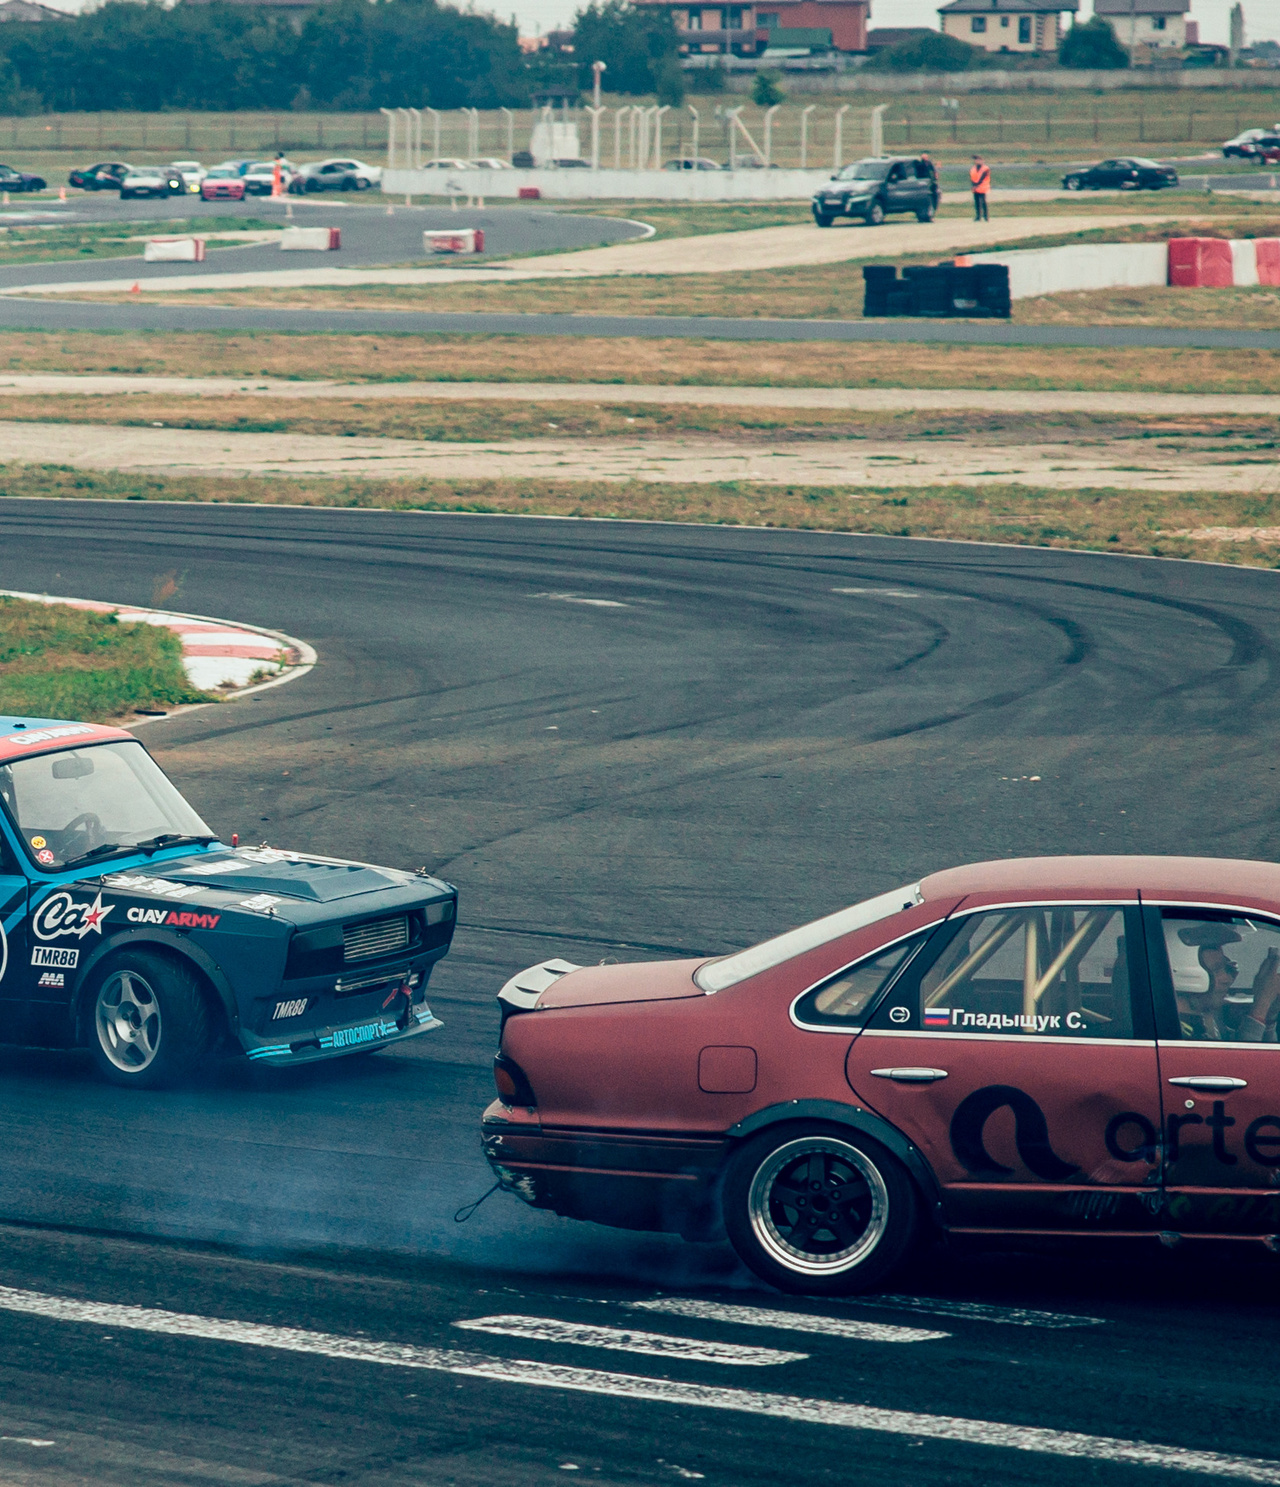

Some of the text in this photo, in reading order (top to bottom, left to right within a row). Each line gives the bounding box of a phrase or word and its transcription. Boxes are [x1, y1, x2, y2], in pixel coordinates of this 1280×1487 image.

[34, 947, 78, 967] TMR88
[272, 998, 308, 1020] TMR88
[951, 1008, 1087, 1032] Гладыщук С.
[333, 1022, 380, 1048] АВТОСПОРТ
[1105, 1100, 1280, 1167] arte
